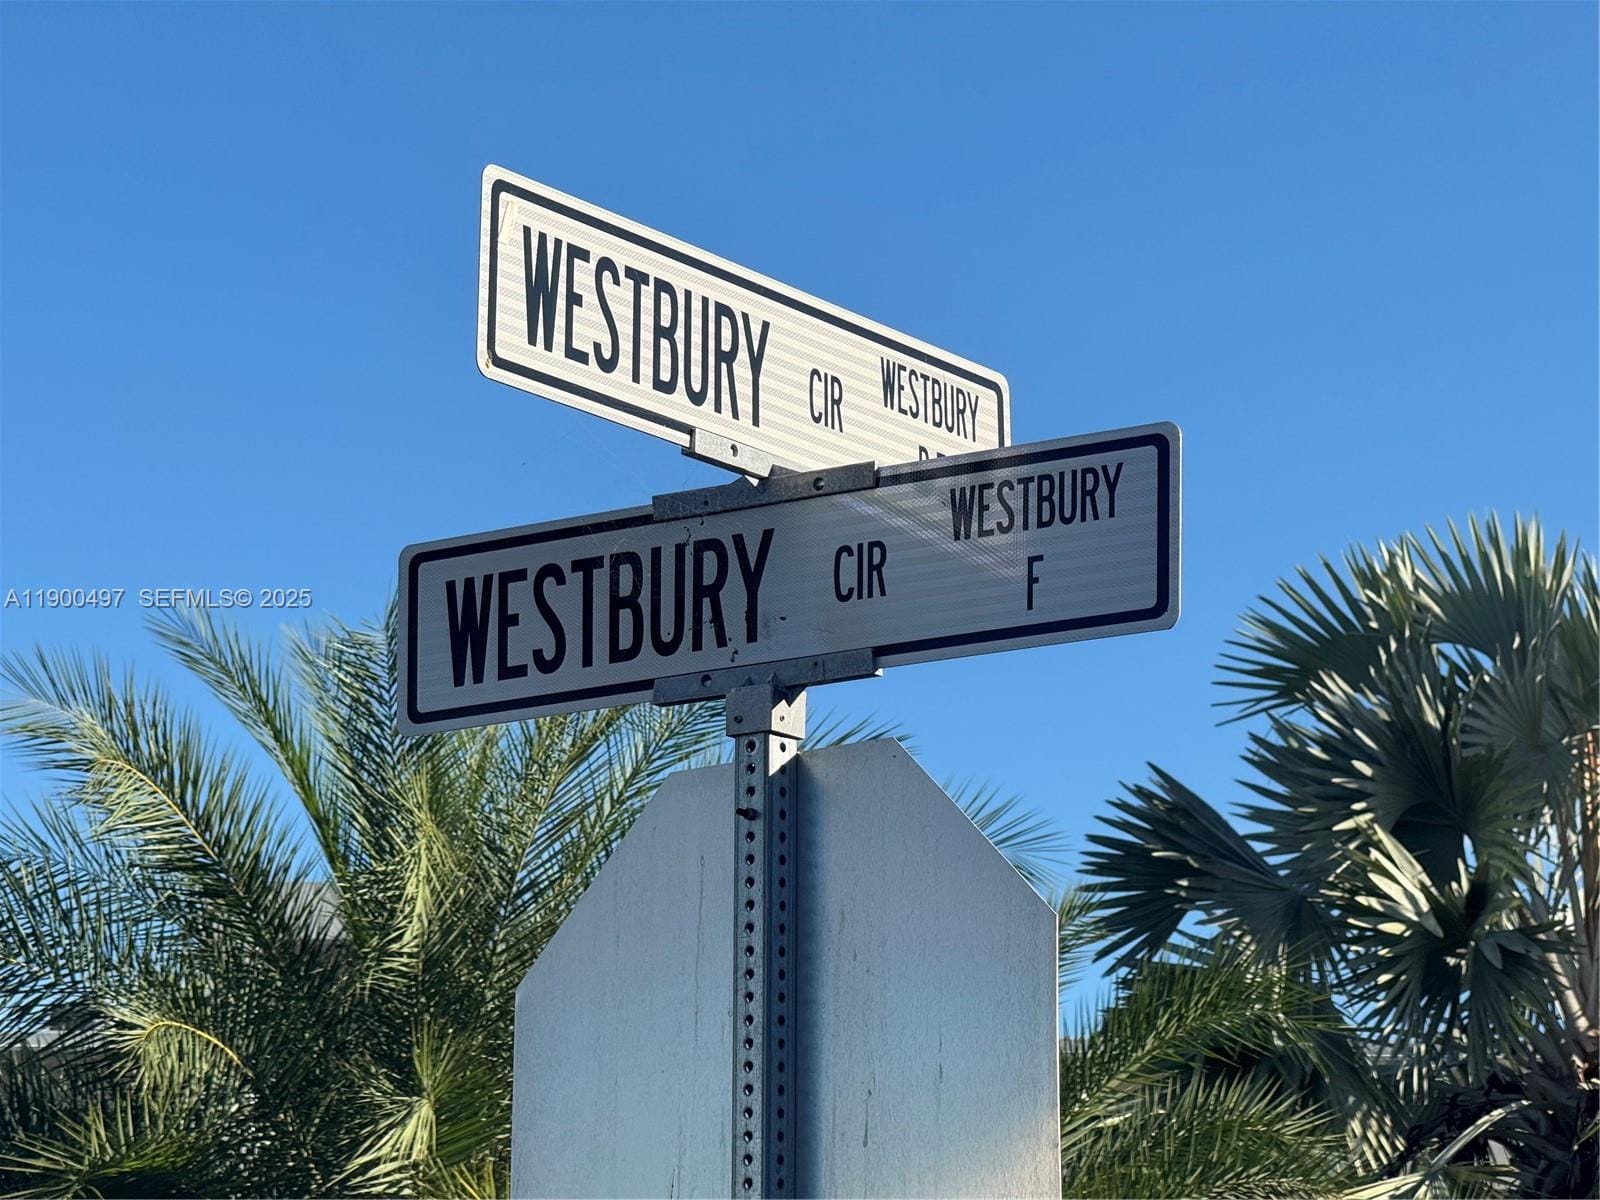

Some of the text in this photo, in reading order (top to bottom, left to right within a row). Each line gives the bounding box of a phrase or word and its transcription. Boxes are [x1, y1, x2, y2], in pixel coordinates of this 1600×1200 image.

[522, 224, 844, 433] WESTBURY CIR
[880, 356, 979, 442] WESTBURY
[949, 462, 1124, 541] WESTBURY
[445, 528, 887, 688] WESTBURY CIR
[1026, 554, 1044, 611] F
